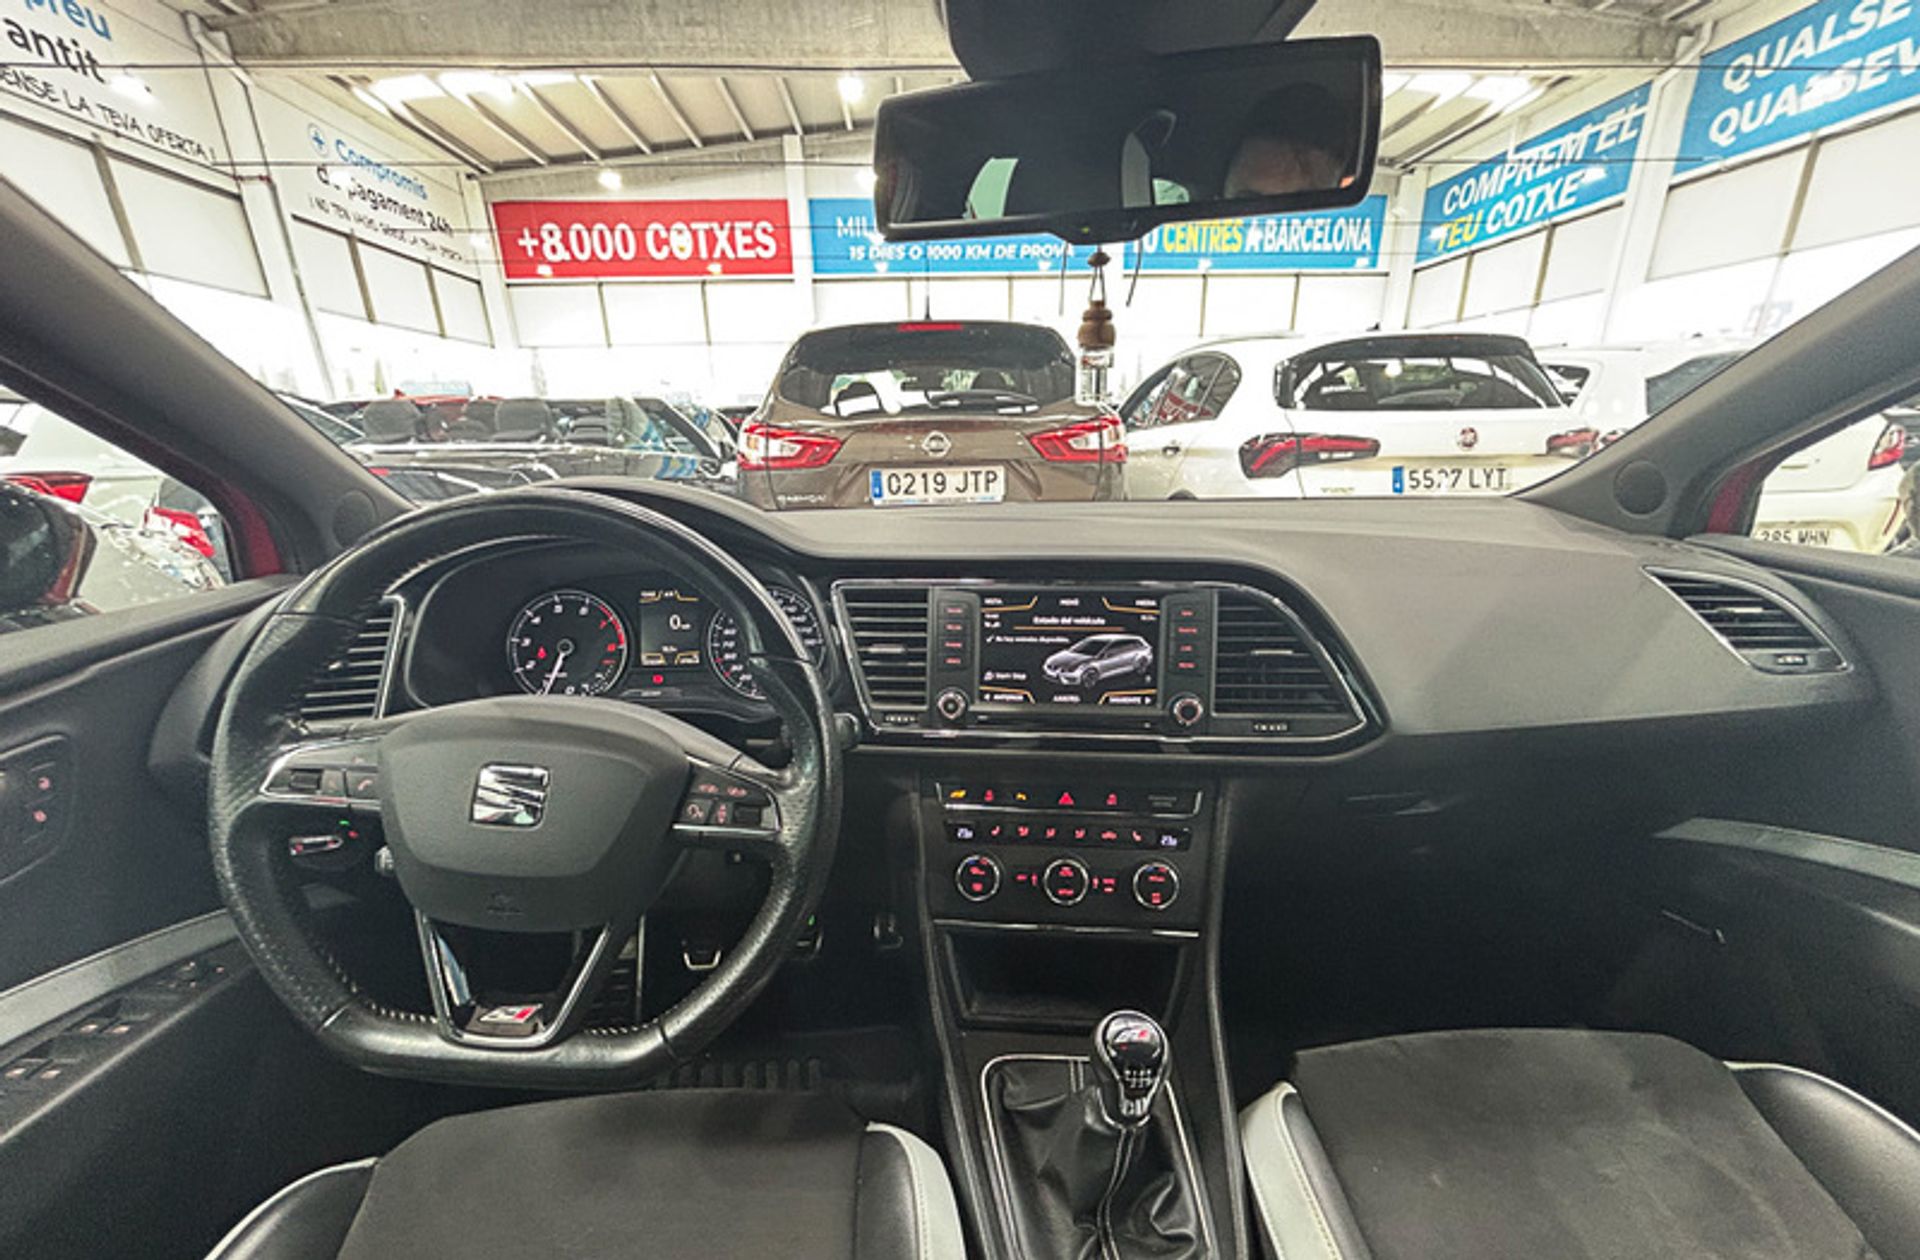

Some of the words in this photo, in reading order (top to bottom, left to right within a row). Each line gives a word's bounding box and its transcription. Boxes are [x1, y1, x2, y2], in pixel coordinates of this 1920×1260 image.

[1723, 0, 1911, 94] QUALSE
[62, 89, 95, 118] LA
[1436, 209, 1484, 251] TEU
[1486, 170, 1586, 233] COTXE
[645, 220, 777, 261] COTXES
[869, 245, 906, 260] DIES
[926, 244, 962, 260] 1000
[965, 244, 990, 259] KM
[992, 244, 1017, 259] DE
[1162, 219, 1244, 254] CENTRES
[1264, 217, 1372, 254] BARCELONA
[955, 470, 998, 493] JTP
[1468, 467, 1508, 489] LYT
